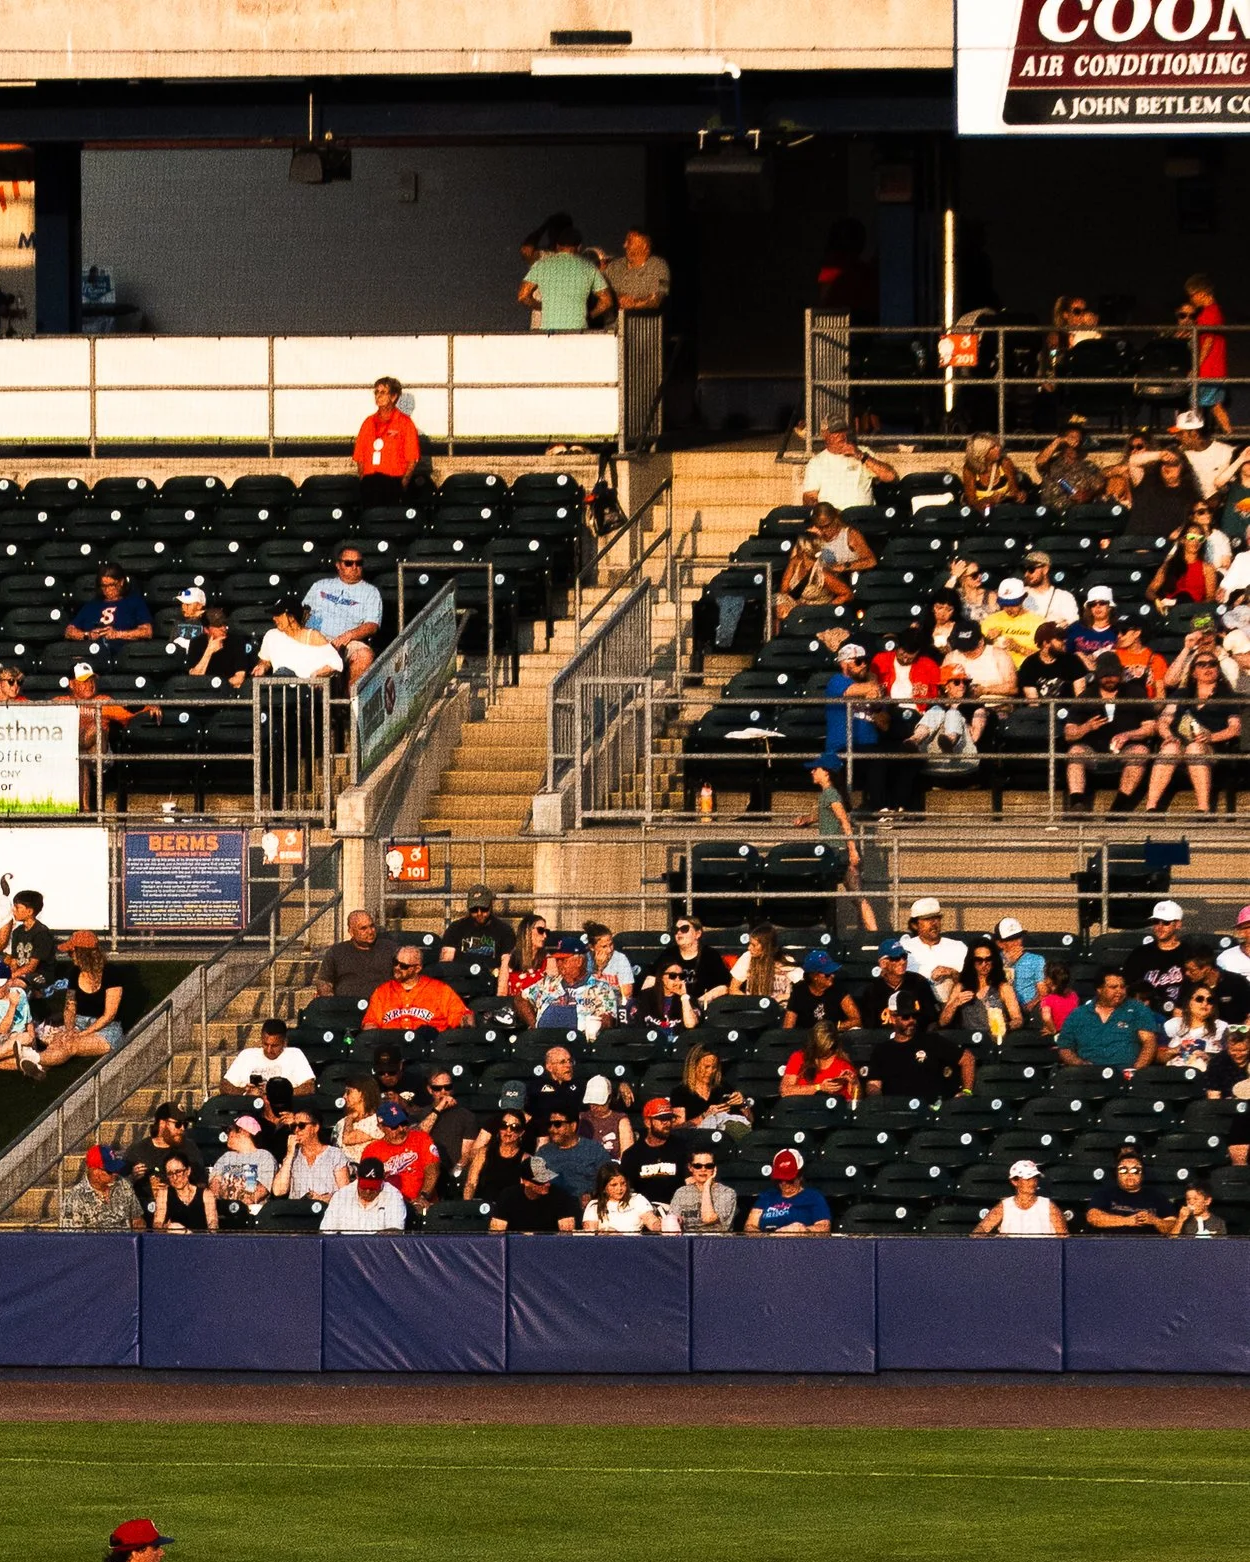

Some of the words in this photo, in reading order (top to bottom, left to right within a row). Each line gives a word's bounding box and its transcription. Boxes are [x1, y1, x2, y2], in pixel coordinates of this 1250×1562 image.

[1019, 55, 1065, 77] AIR
[1073, 52, 1249, 77] CONDITIONING
[1051, 97, 1068, 116] A
[1069, 96, 1131, 119] JOHN
[1135, 95, 1223, 116] BETLEM
[955, 354, 975, 365] 201
[0, 769, 21, 779] CNY
[148, 834, 220, 852] BERMS
[406, 866, 425, 878] 101
